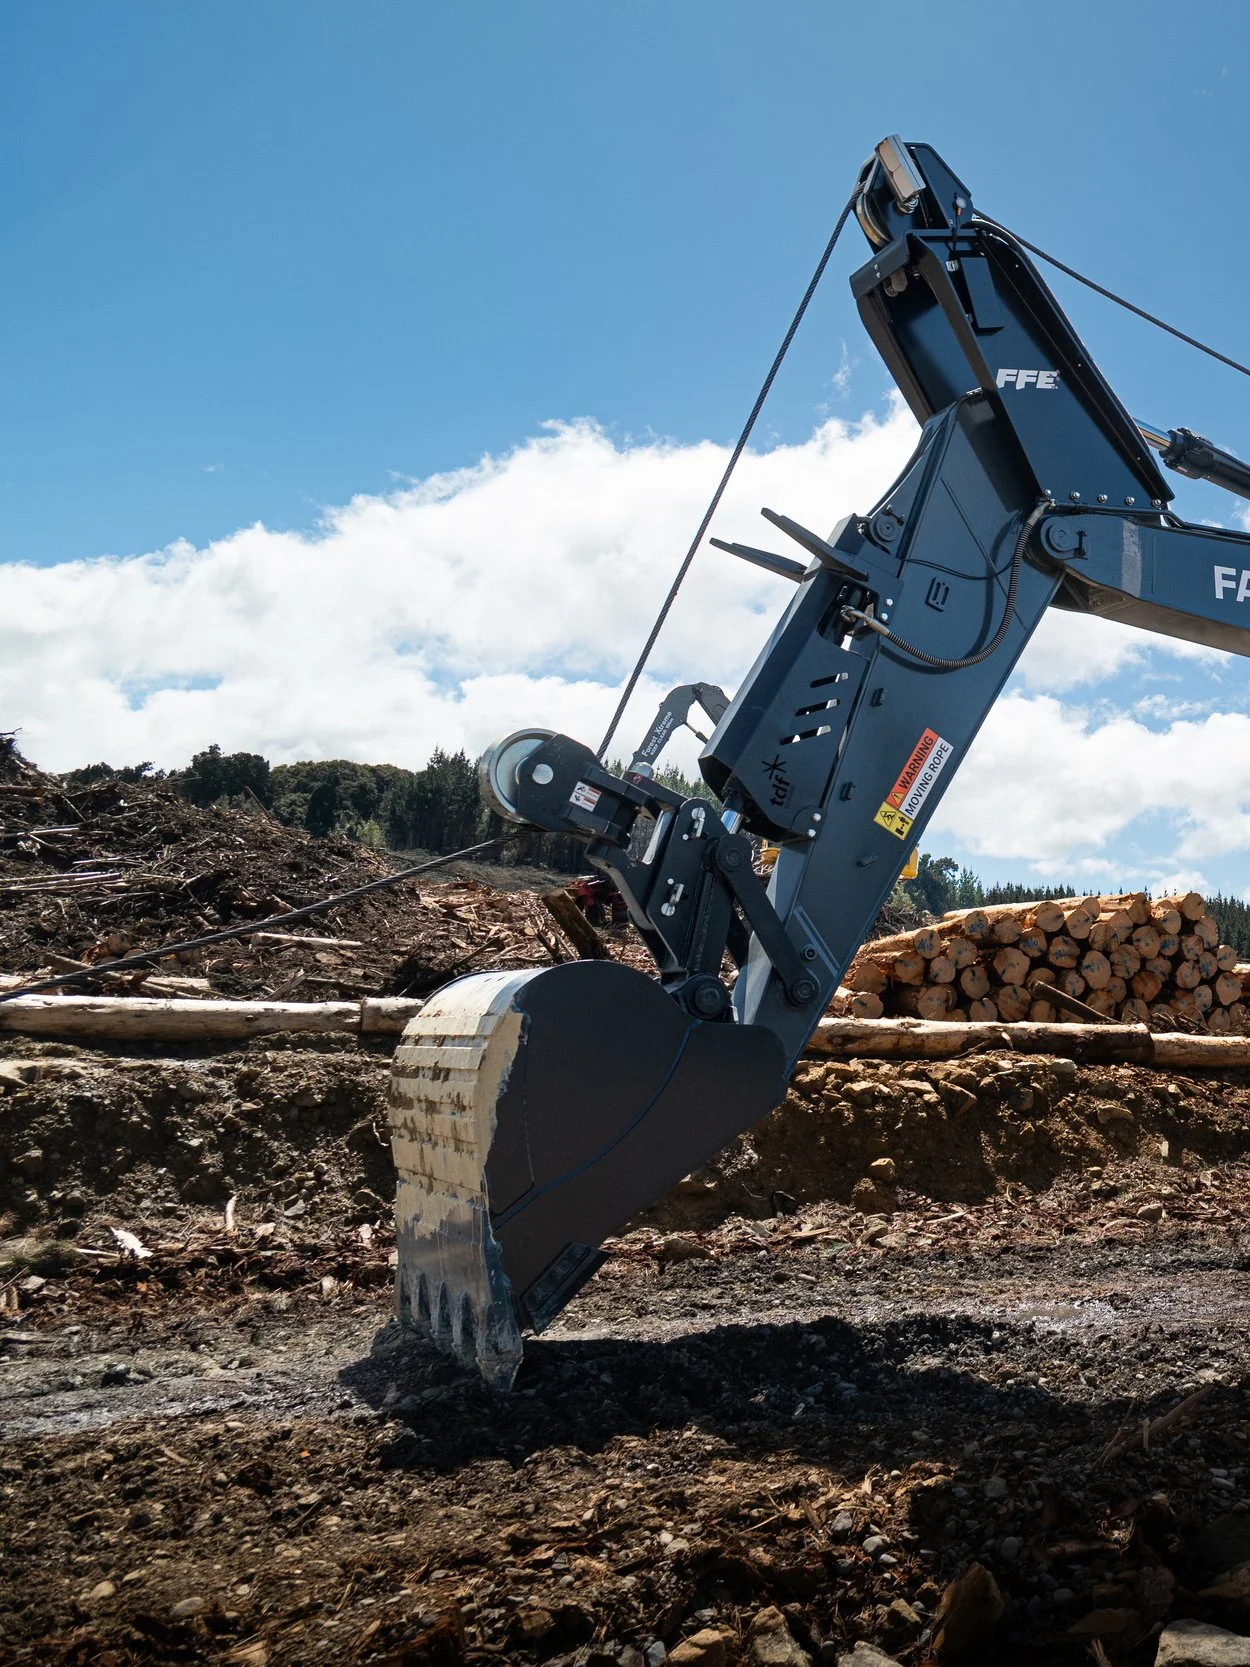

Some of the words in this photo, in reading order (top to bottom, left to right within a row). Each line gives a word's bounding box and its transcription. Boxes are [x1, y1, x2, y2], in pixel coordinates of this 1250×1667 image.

[996, 368, 1060, 390] FFE
[641, 736, 658, 757] Forest
[654, 711, 672, 735] Xtreme
[898, 735, 934, 790] WARNING
[905, 772, 933, 816] MOVING
[928, 743, 950, 773] ROPE
[769, 774, 791, 806] tdf
